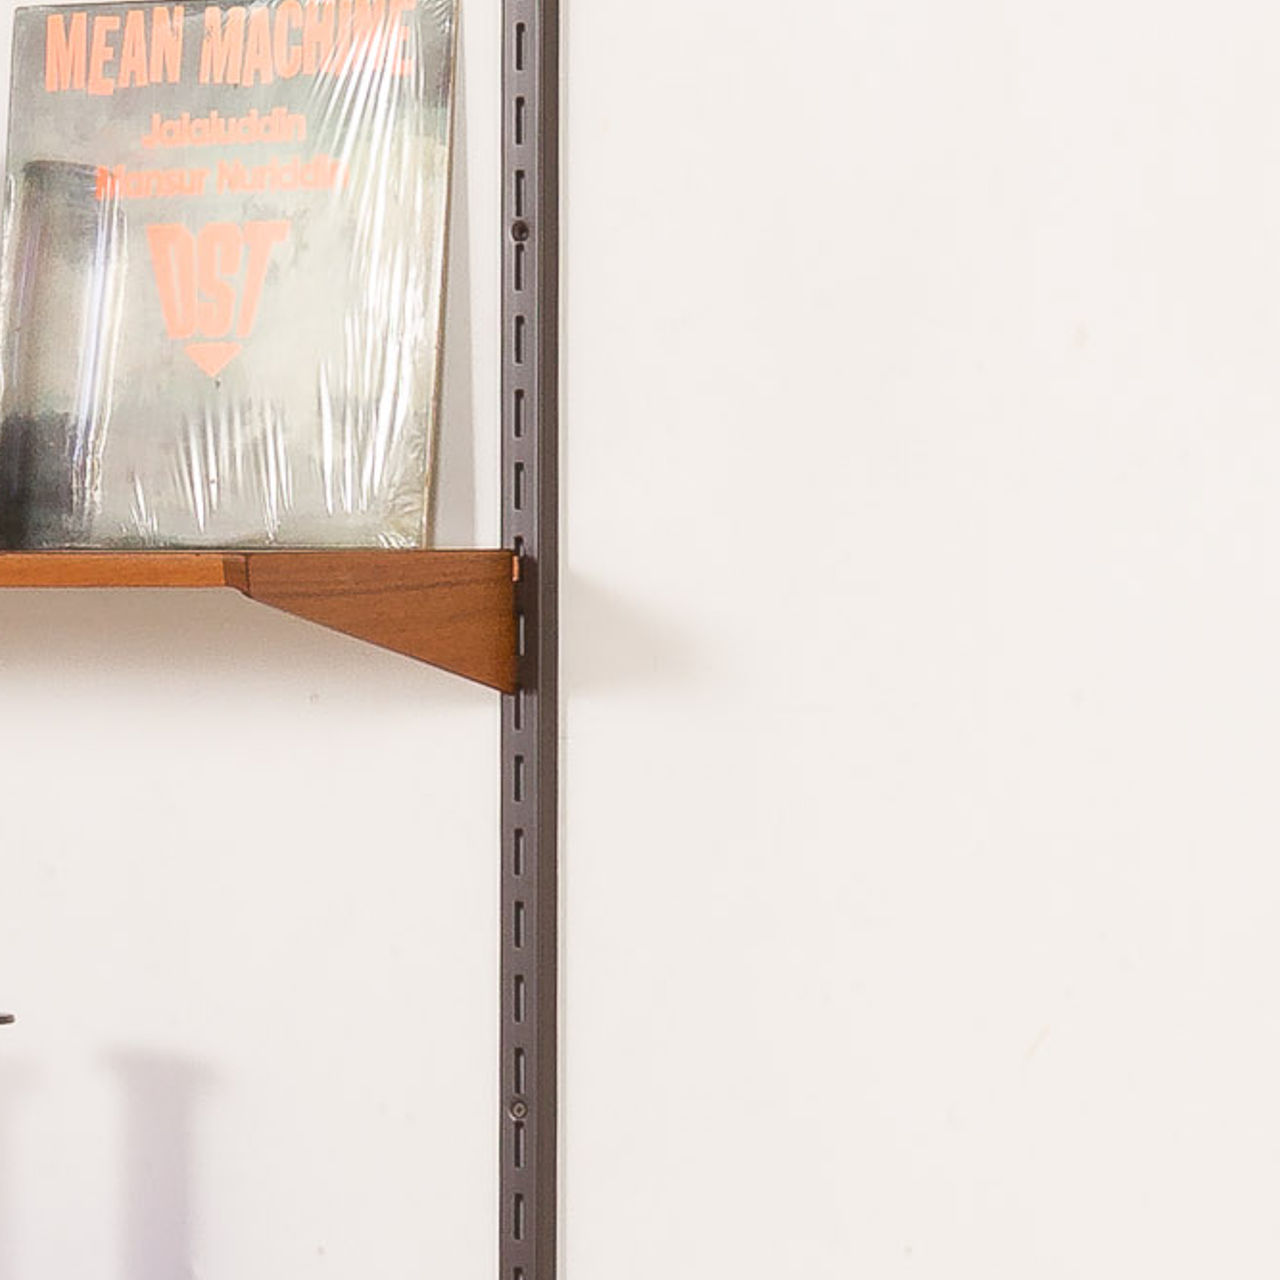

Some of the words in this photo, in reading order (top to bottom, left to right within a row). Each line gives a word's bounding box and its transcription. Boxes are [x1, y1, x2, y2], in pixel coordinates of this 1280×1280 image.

[44, 5, 185, 96] MEAN
[142, 106, 306, 148] Jalaluddin
[95, 163, 211, 200] Mansur
[146, 219, 292, 339] DST
